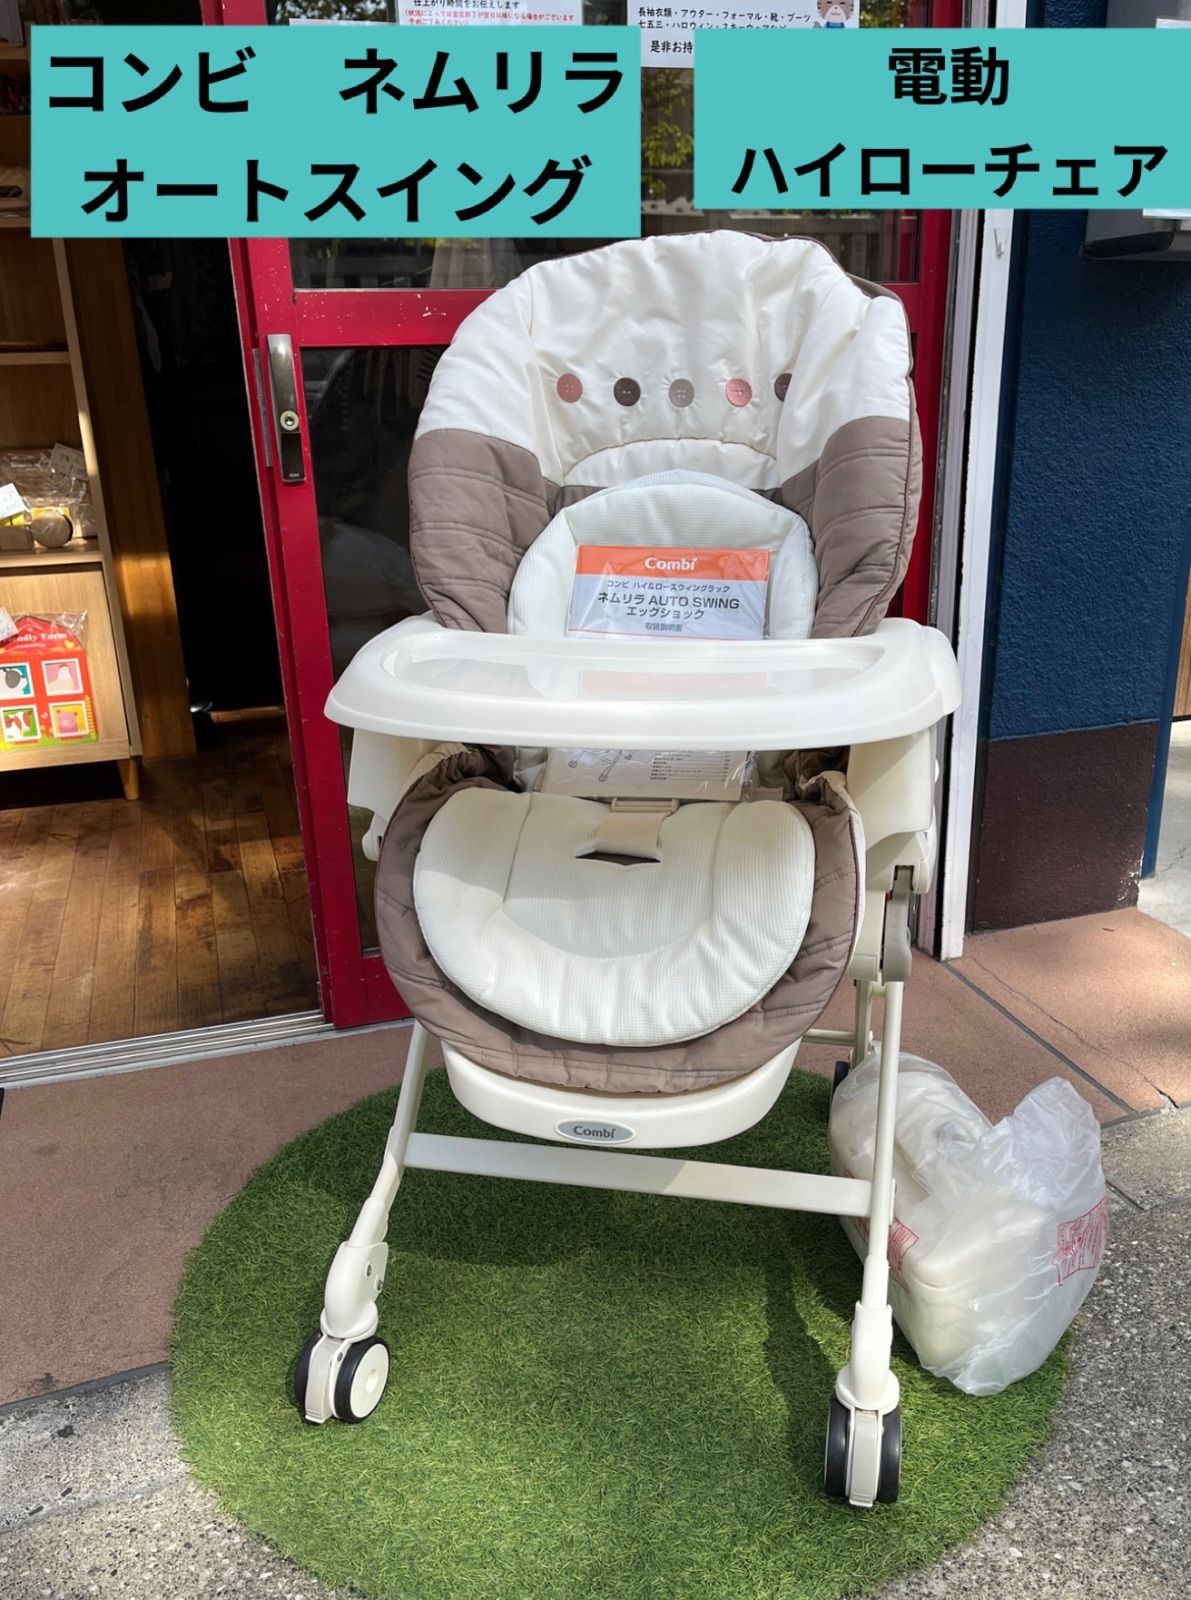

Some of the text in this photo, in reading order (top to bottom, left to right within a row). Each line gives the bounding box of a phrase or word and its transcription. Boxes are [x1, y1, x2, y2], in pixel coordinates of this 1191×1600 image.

[644, 557, 699, 571] Combi
[607, 580, 630, 588] コンビ
[599, 592, 740, 609] ネムリラ AUTO SWING
[626, 606, 705, 620] エッグショック
[573, 1125, 616, 1138] Combi
